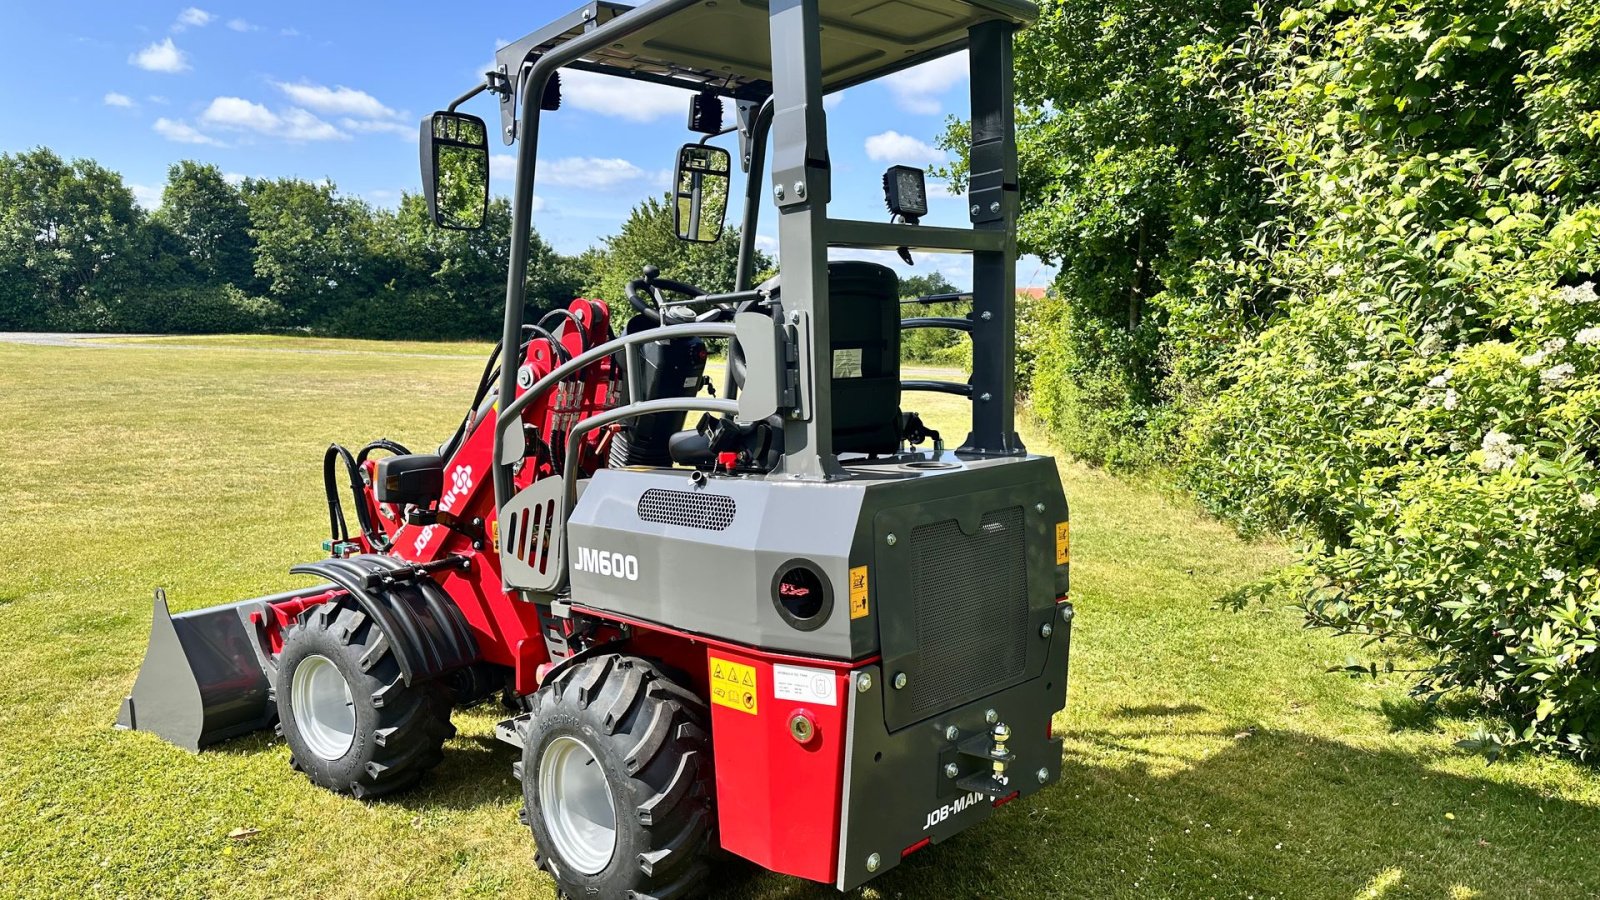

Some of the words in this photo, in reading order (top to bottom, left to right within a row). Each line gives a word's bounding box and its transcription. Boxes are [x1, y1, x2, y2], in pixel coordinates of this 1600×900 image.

[413, 490, 456, 557] JOB-AN
[574, 546, 639, 581] JM600
[922, 791, 984, 831] JOB-MAN
